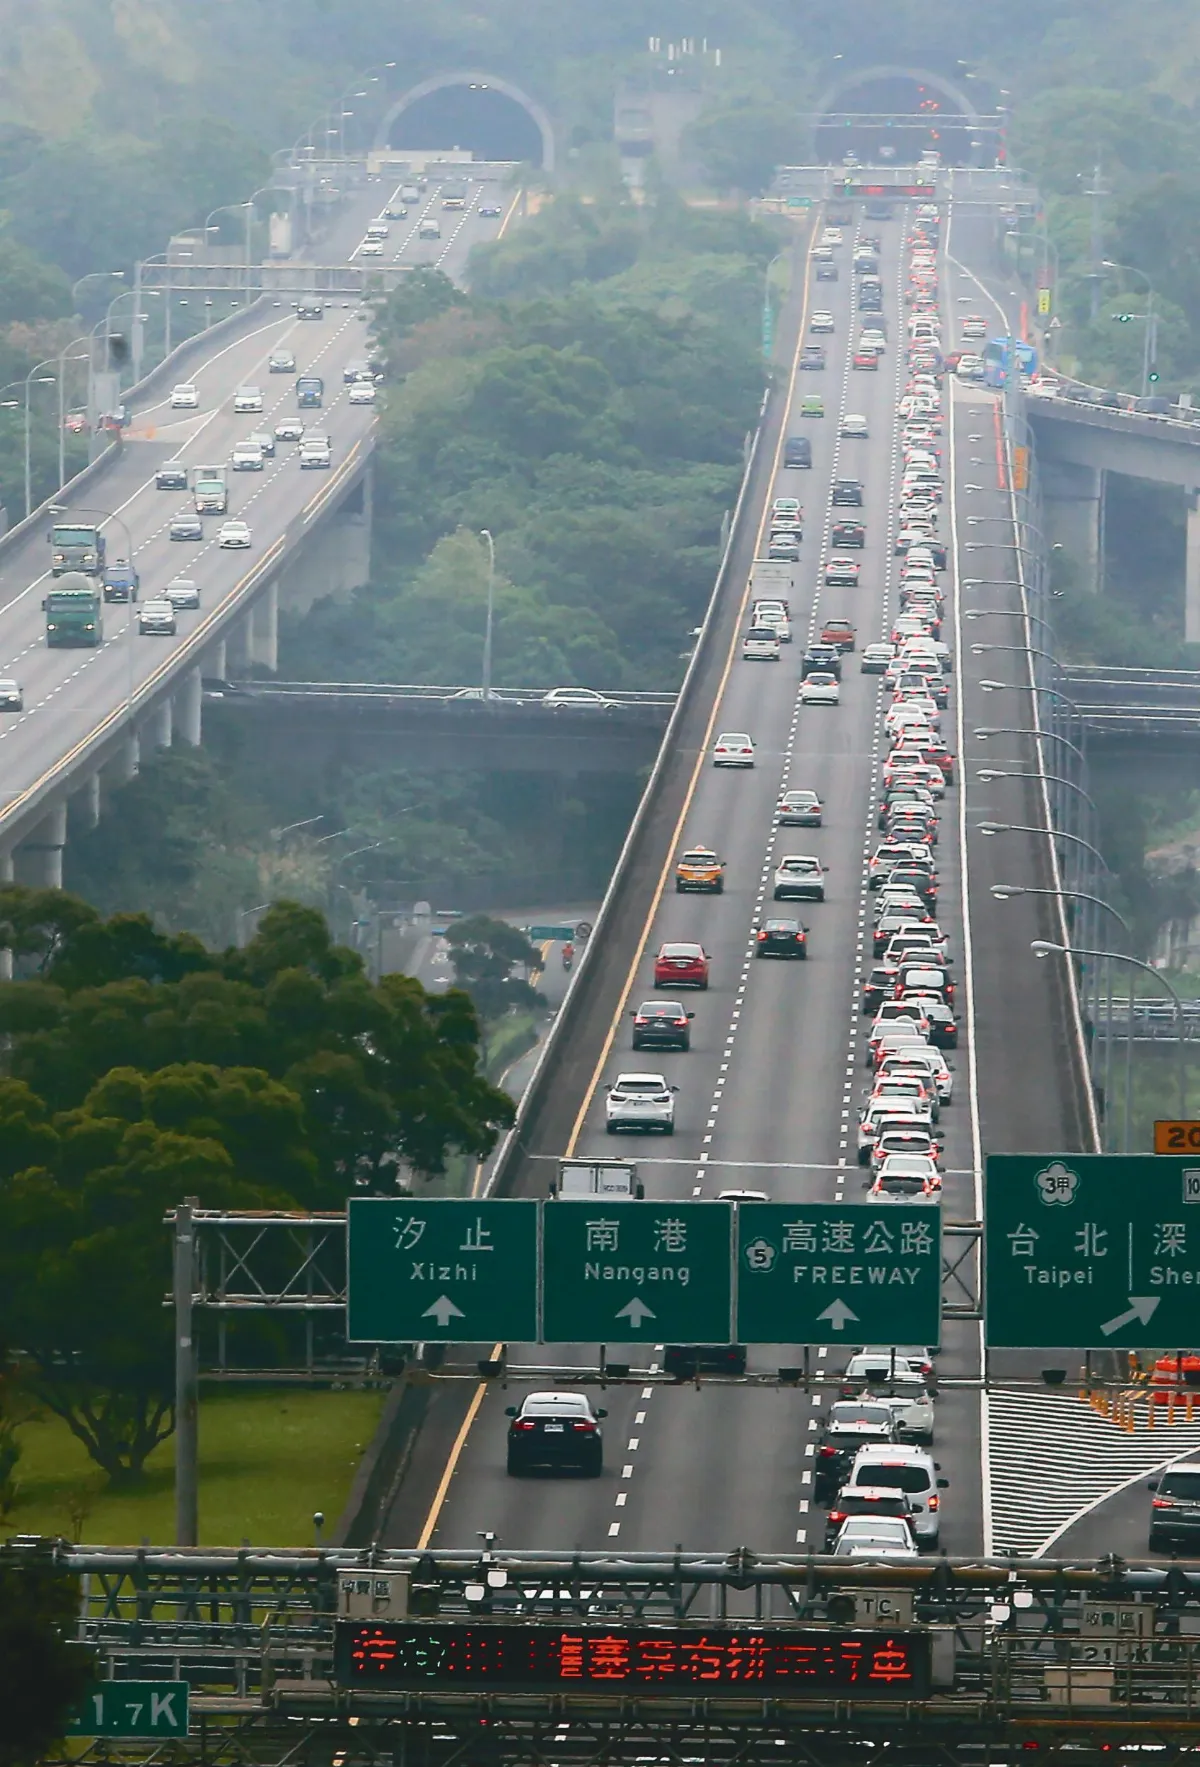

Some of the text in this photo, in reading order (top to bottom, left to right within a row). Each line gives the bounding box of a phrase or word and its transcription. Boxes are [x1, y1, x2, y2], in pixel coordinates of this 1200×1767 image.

[1045, 1177, 1069, 1194] 3甲
[393, 1217, 493, 1251] 汐止
[586, 1218, 686, 1252] 南港
[783, 1220, 934, 1255] 高速公路
[1007, 1222, 1107, 1257] 台北
[1153, 1223, 1187, 1257] 深
[754, 1248, 767, 1264] 5
[410, 1263, 476, 1281] Xizhi
[585, 1263, 690, 1286] Nangang
[794, 1266, 920, 1285] FREEWAY
[1023, 1265, 1092, 1288] Taipei
